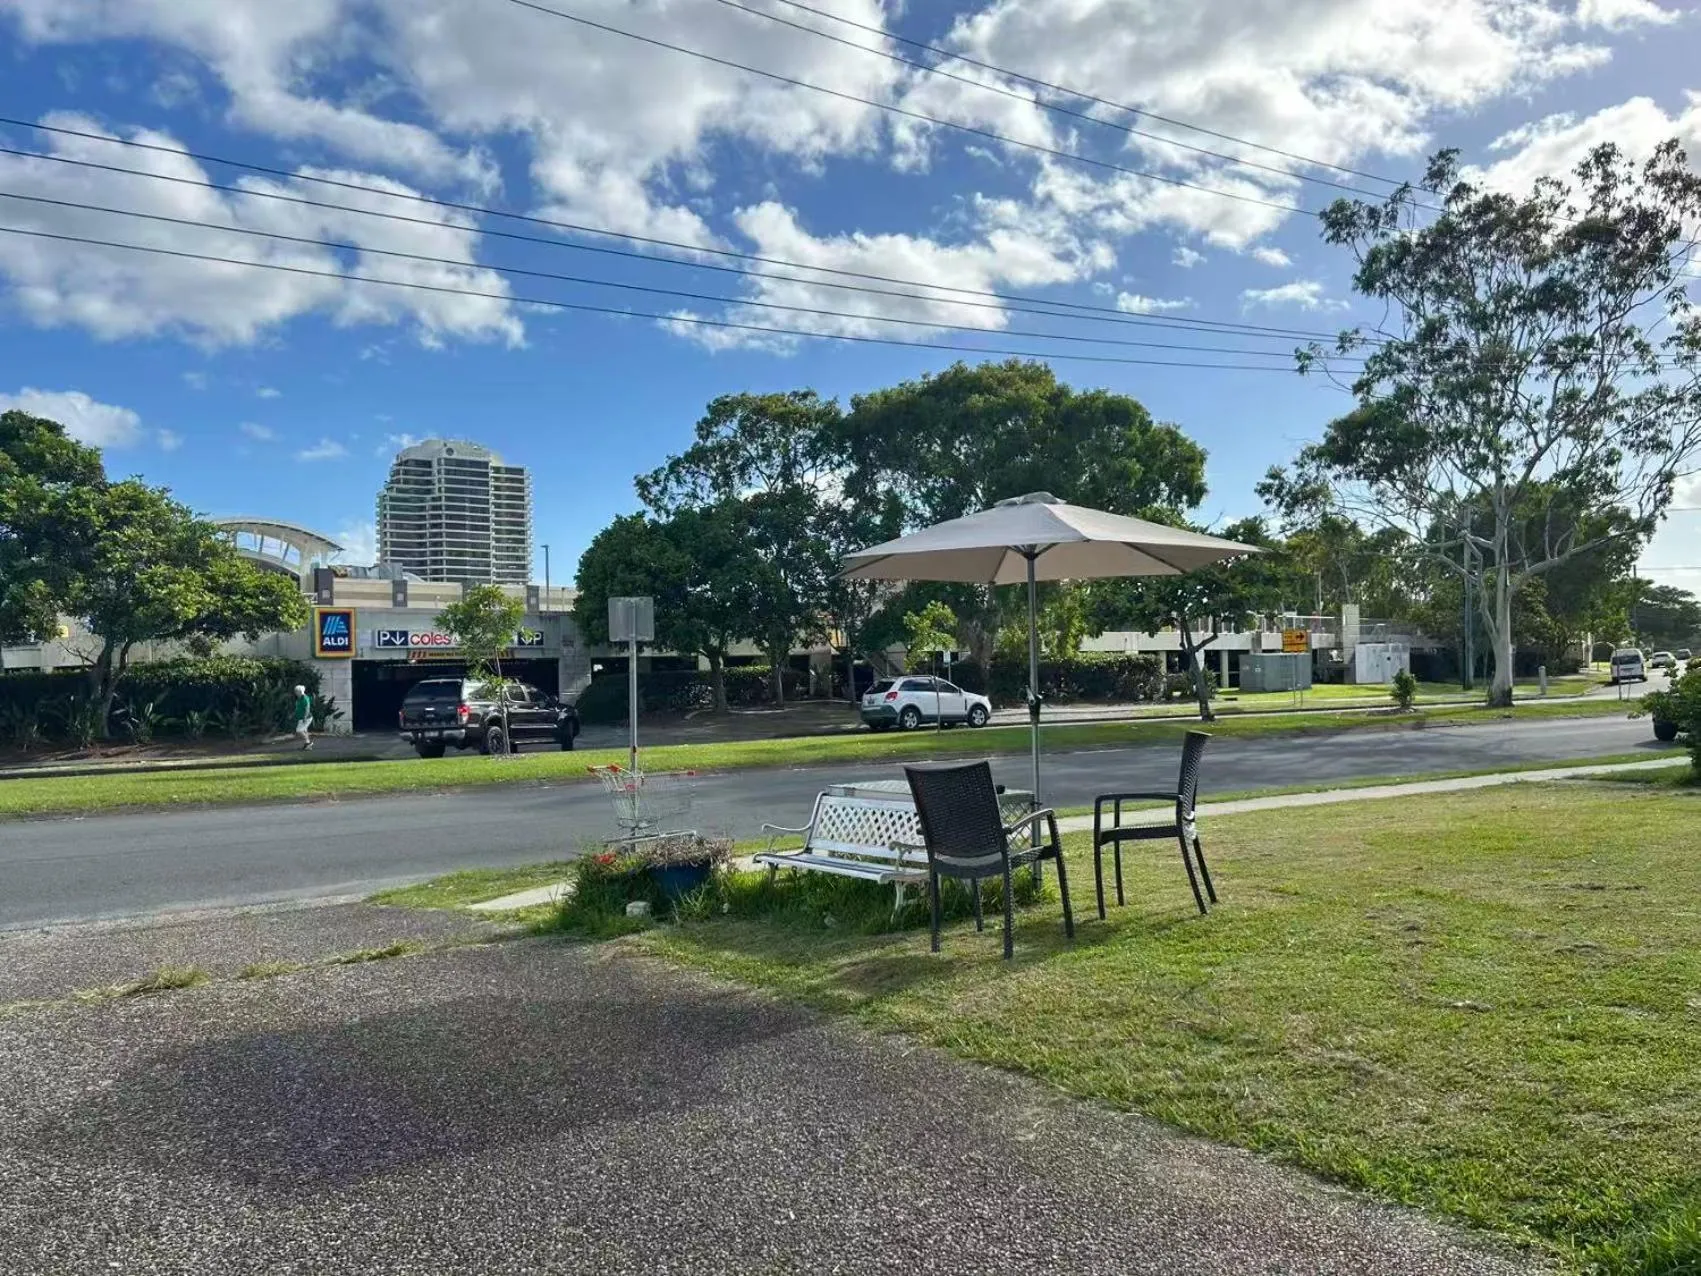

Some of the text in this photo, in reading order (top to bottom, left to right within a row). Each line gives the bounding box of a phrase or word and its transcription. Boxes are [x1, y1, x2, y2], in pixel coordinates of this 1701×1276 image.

[323, 636, 348, 646] ALDI
[380, 631, 541, 645] P coles P
